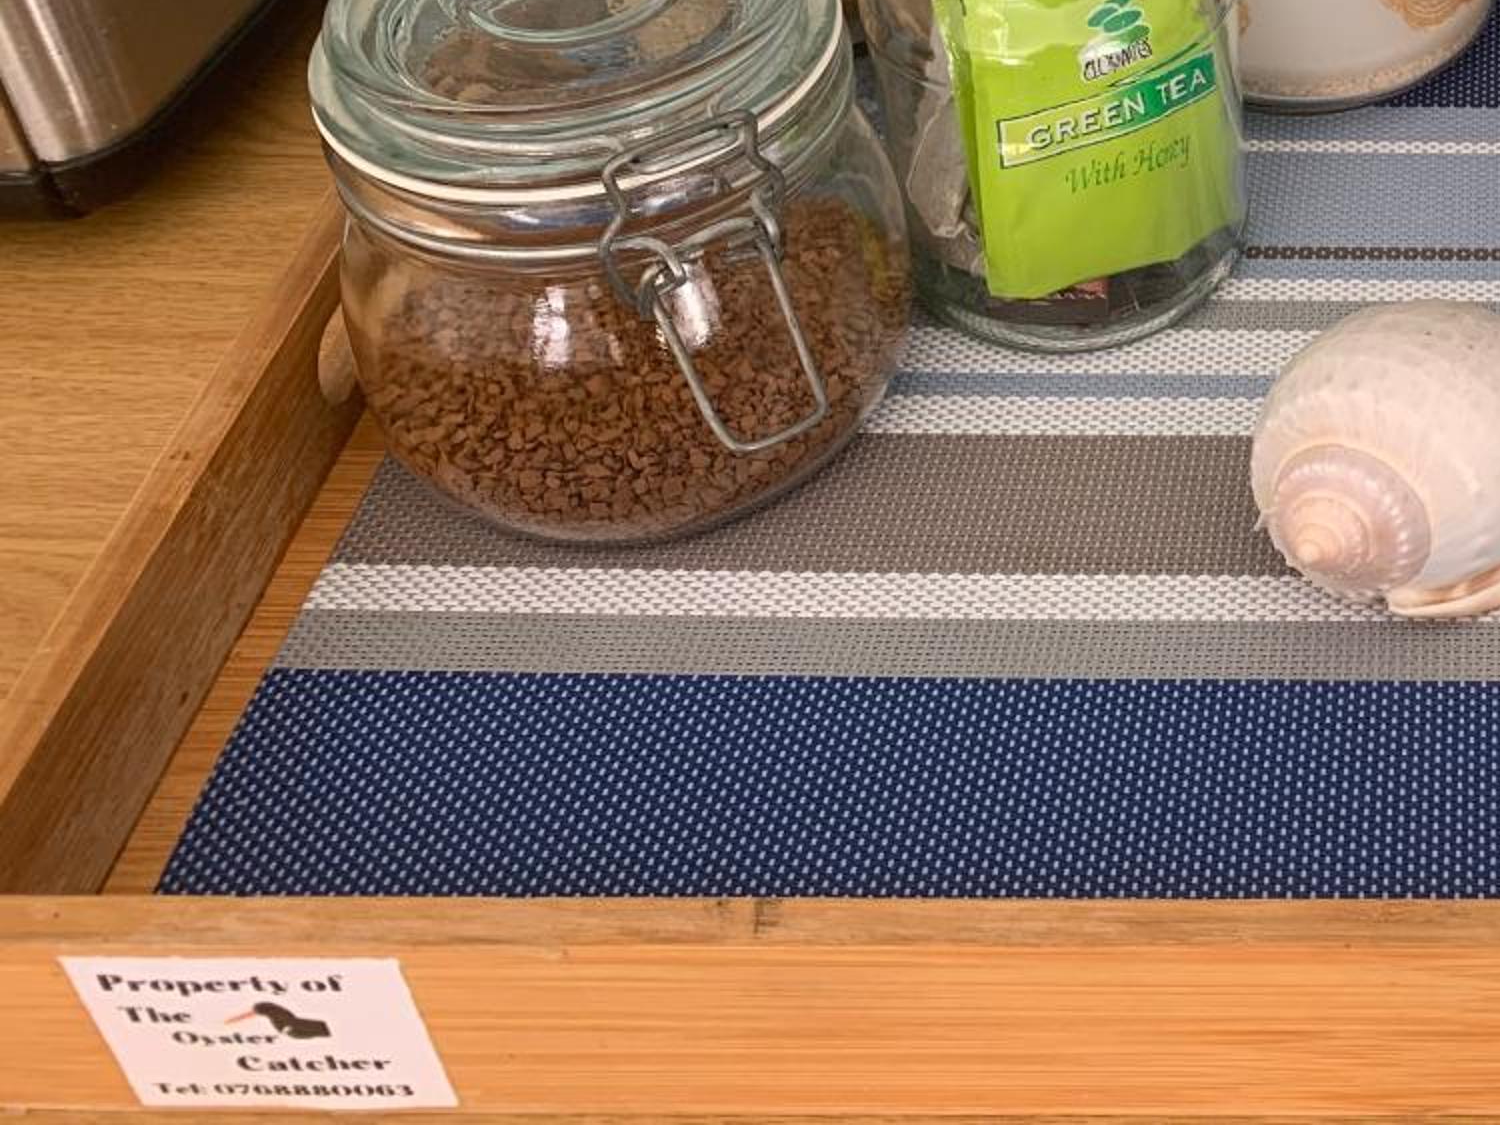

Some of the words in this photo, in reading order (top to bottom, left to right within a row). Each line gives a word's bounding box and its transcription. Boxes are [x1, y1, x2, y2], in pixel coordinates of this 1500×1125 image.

[1026, 89, 1146, 152] GREEN
[1158, 70, 1207, 106] TEA
[1065, 150, 1125, 195] With
[95, 973, 290, 997] Property
[299, 973, 344, 993] of
[117, 1005, 192, 1024] The
[171, 1029, 280, 1047] Oyster
[236, 1055, 392, 1074] Catcher
